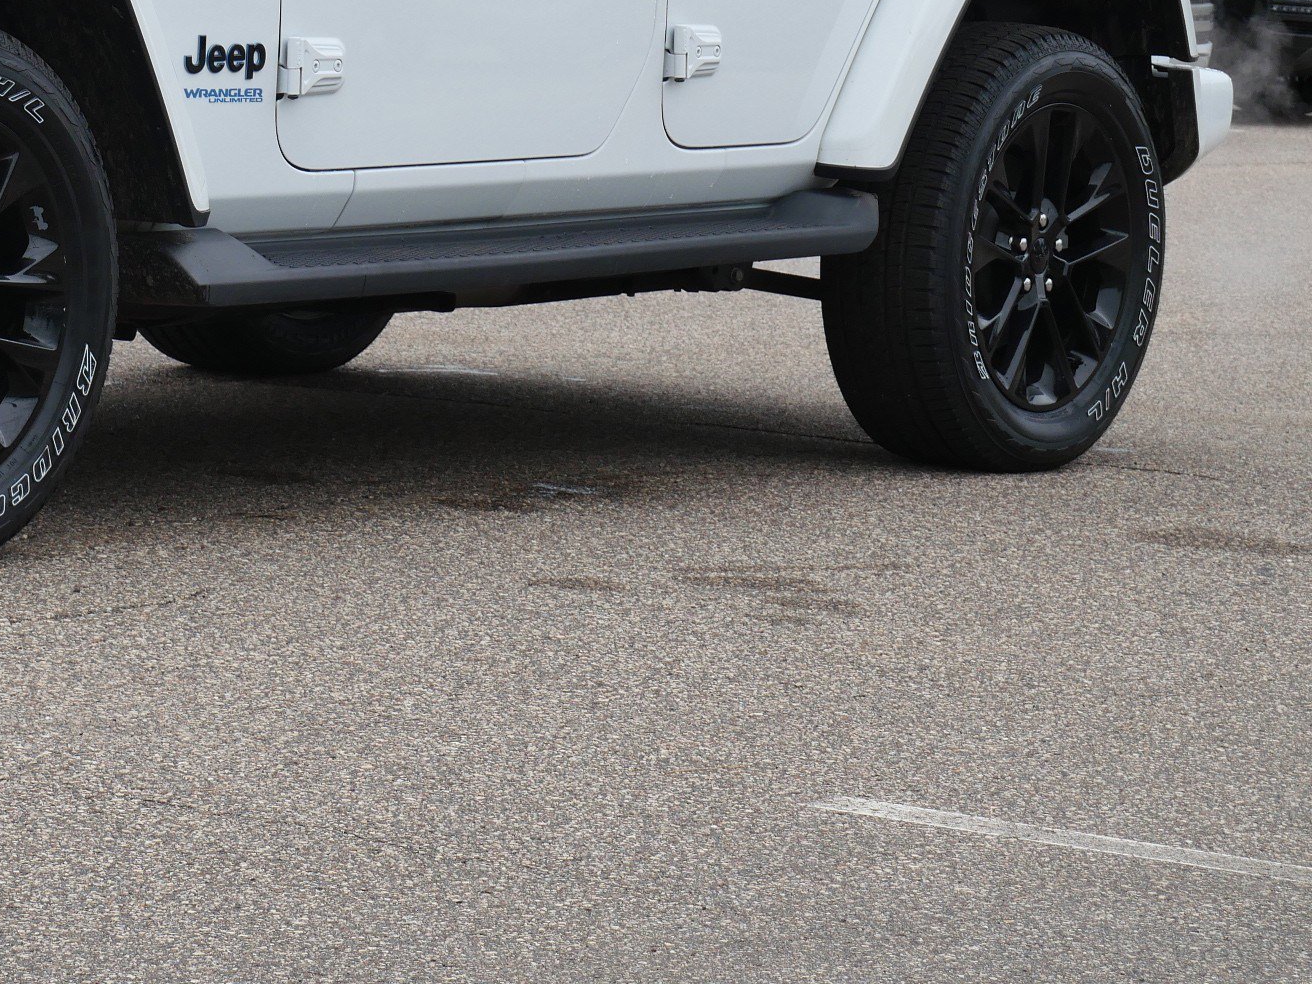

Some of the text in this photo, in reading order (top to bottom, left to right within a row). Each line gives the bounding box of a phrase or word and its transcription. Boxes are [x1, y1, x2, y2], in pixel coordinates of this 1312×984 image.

[183, 34, 266, 80] Jeep
[183, 88, 263, 99] WRANGLER
[1134, 145, 1161, 348] DUELER
